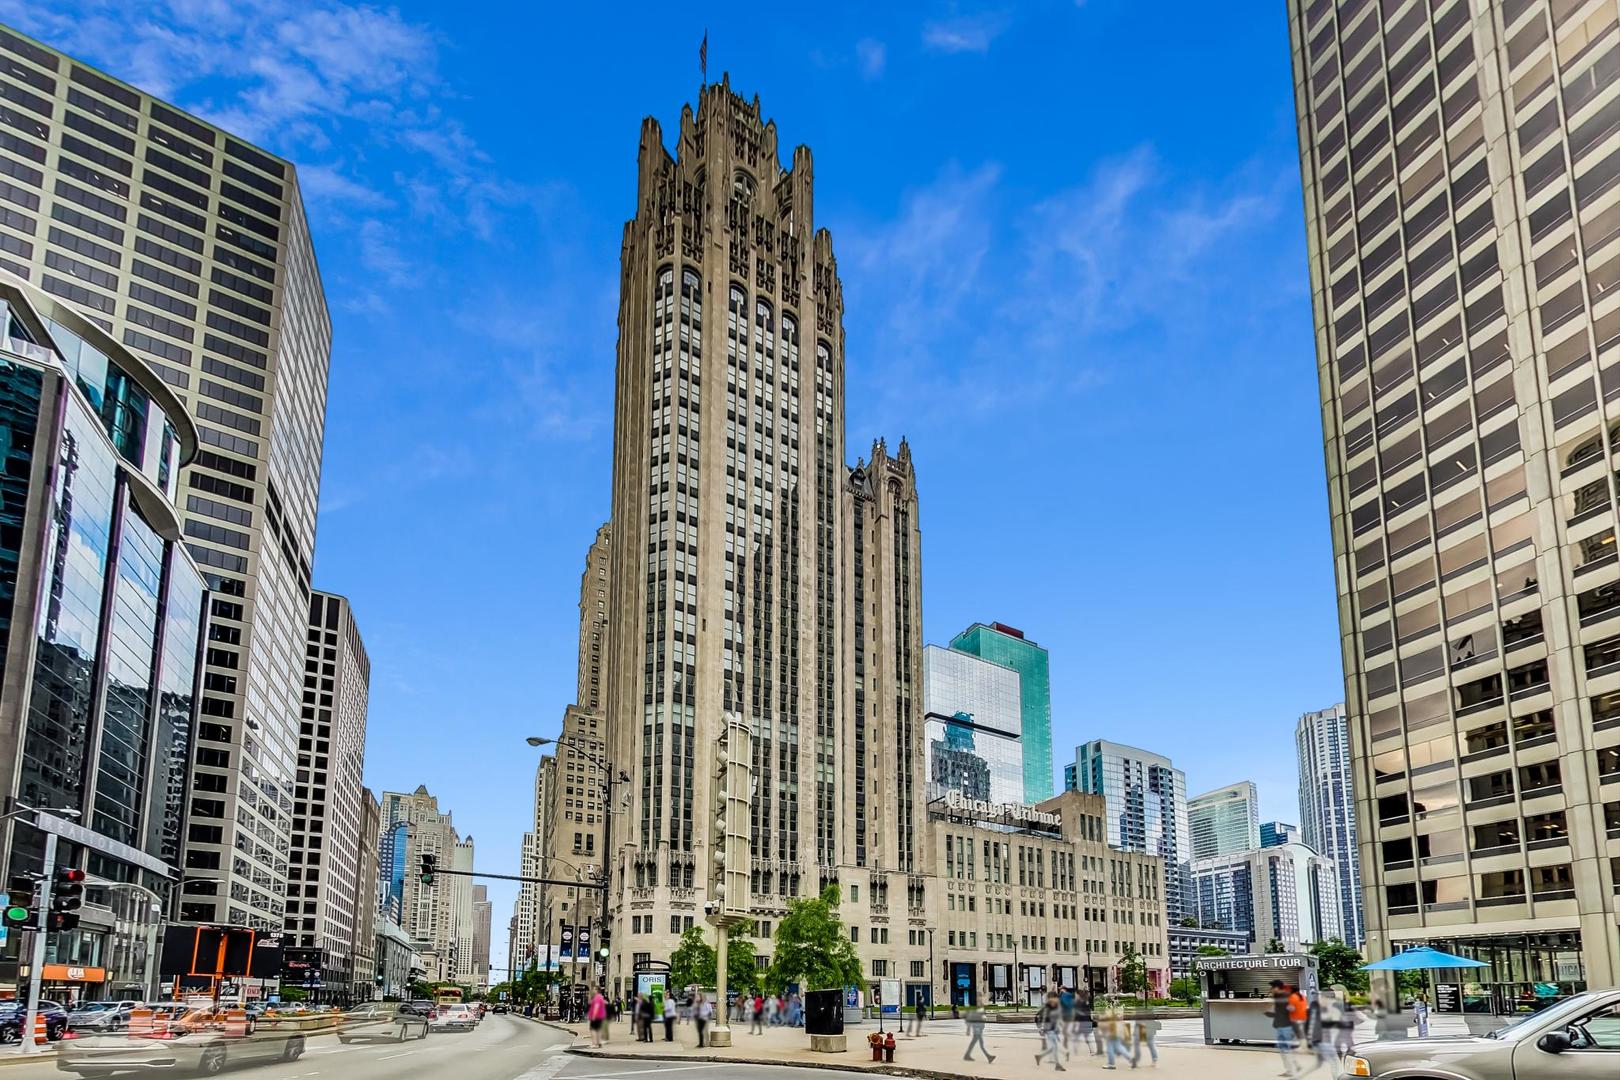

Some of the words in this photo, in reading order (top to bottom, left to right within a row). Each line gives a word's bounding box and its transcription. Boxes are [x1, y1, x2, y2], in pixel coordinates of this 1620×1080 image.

[945, 789, 1005, 817] Chicago
[1005, 801, 1062, 826] Tribune
[1195, 960, 1269, 970] ARCHITECTURE
[1271, 957, 1301, 968] TOUR
